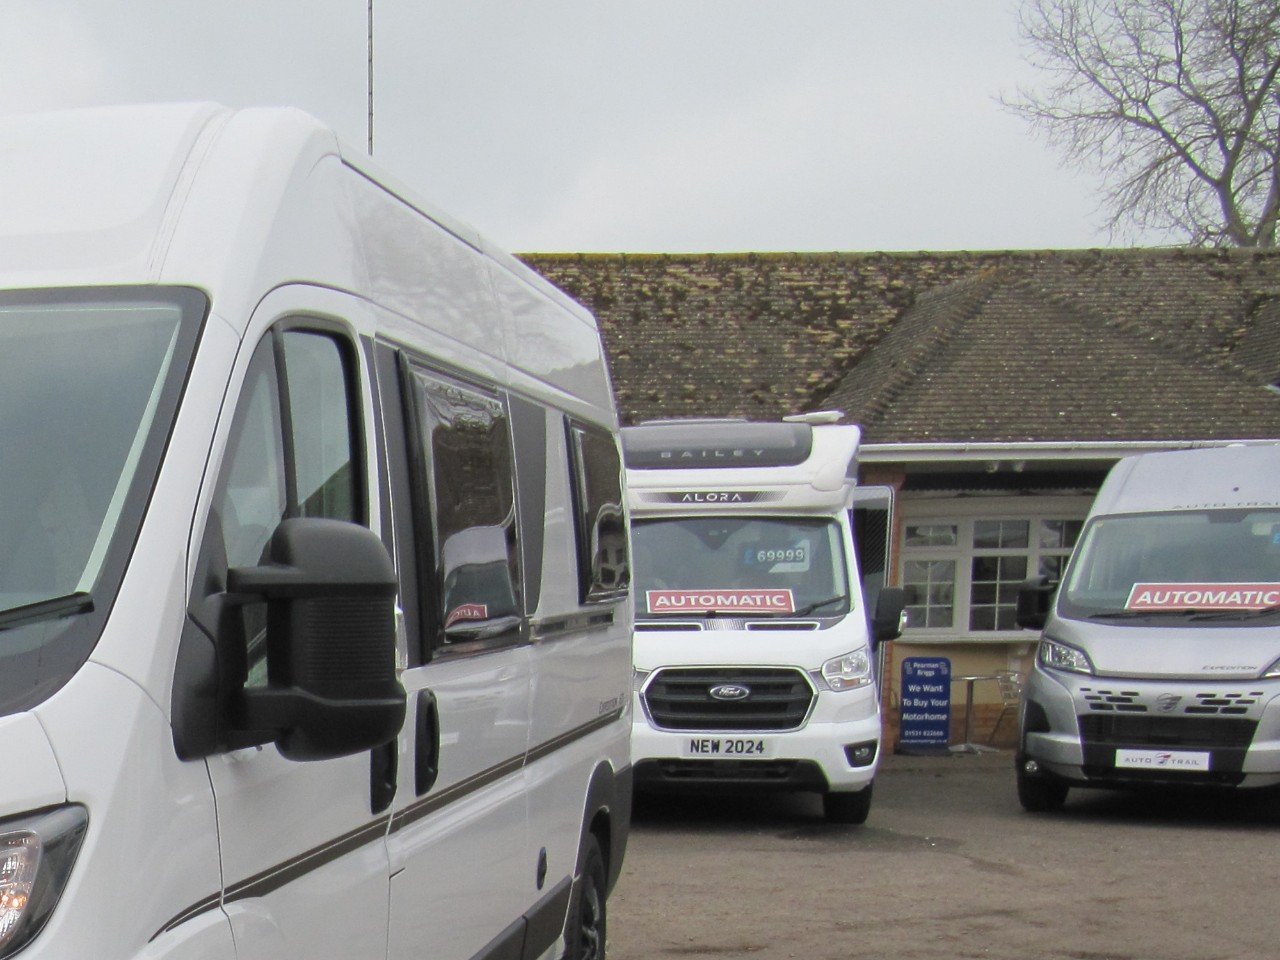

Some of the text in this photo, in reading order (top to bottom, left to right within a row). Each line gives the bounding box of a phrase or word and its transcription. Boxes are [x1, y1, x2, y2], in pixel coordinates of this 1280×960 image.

[661, 449, 764, 458] BAILEY
[682, 492, 743, 502] ALORA
[655, 594, 787, 607] AUTOMATIC
[1135, 591, 1280, 605] AUTOMATIC
[908, 684, 944, 693] We Want
[903, 698, 948, 708] To Buy Your
[902, 712, 948, 721] Motorhome
[690, 739, 765, 754] NEW 2024
[1124, 756, 1200, 766] AUTO TRAIL
